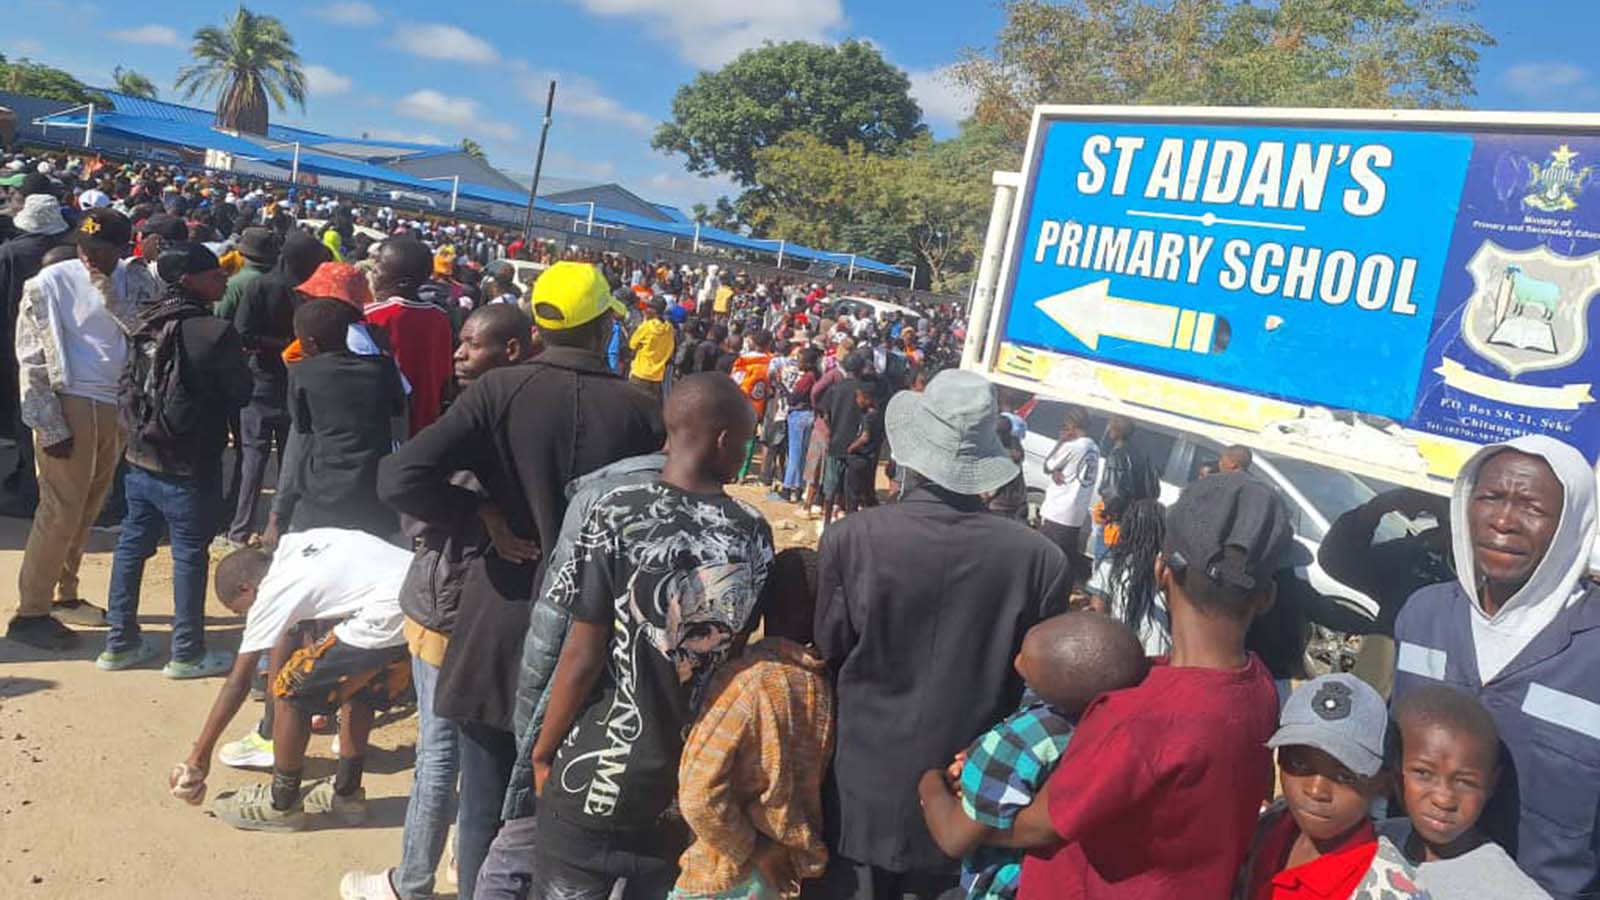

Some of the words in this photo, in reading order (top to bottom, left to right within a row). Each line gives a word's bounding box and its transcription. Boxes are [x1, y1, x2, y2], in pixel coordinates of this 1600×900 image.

[1076, 134, 1145, 196] ST
[1143, 137, 1393, 217] AIDAN'S
[1472, 220, 1505, 231] Primary
[1506, 224, 1525, 233] and
[1526, 225, 1573, 237] Secondary
[1560, 219, 1572, 228] of
[1034, 219, 1214, 285] PRIMARY
[1218, 238, 1419, 316] SCHOOL
[1469, 403, 1491, 416] Box
[1495, 408, 1514, 421] SK
[1539, 417, 1573, 433] Seke
[561, 697, 642, 816] NAME
